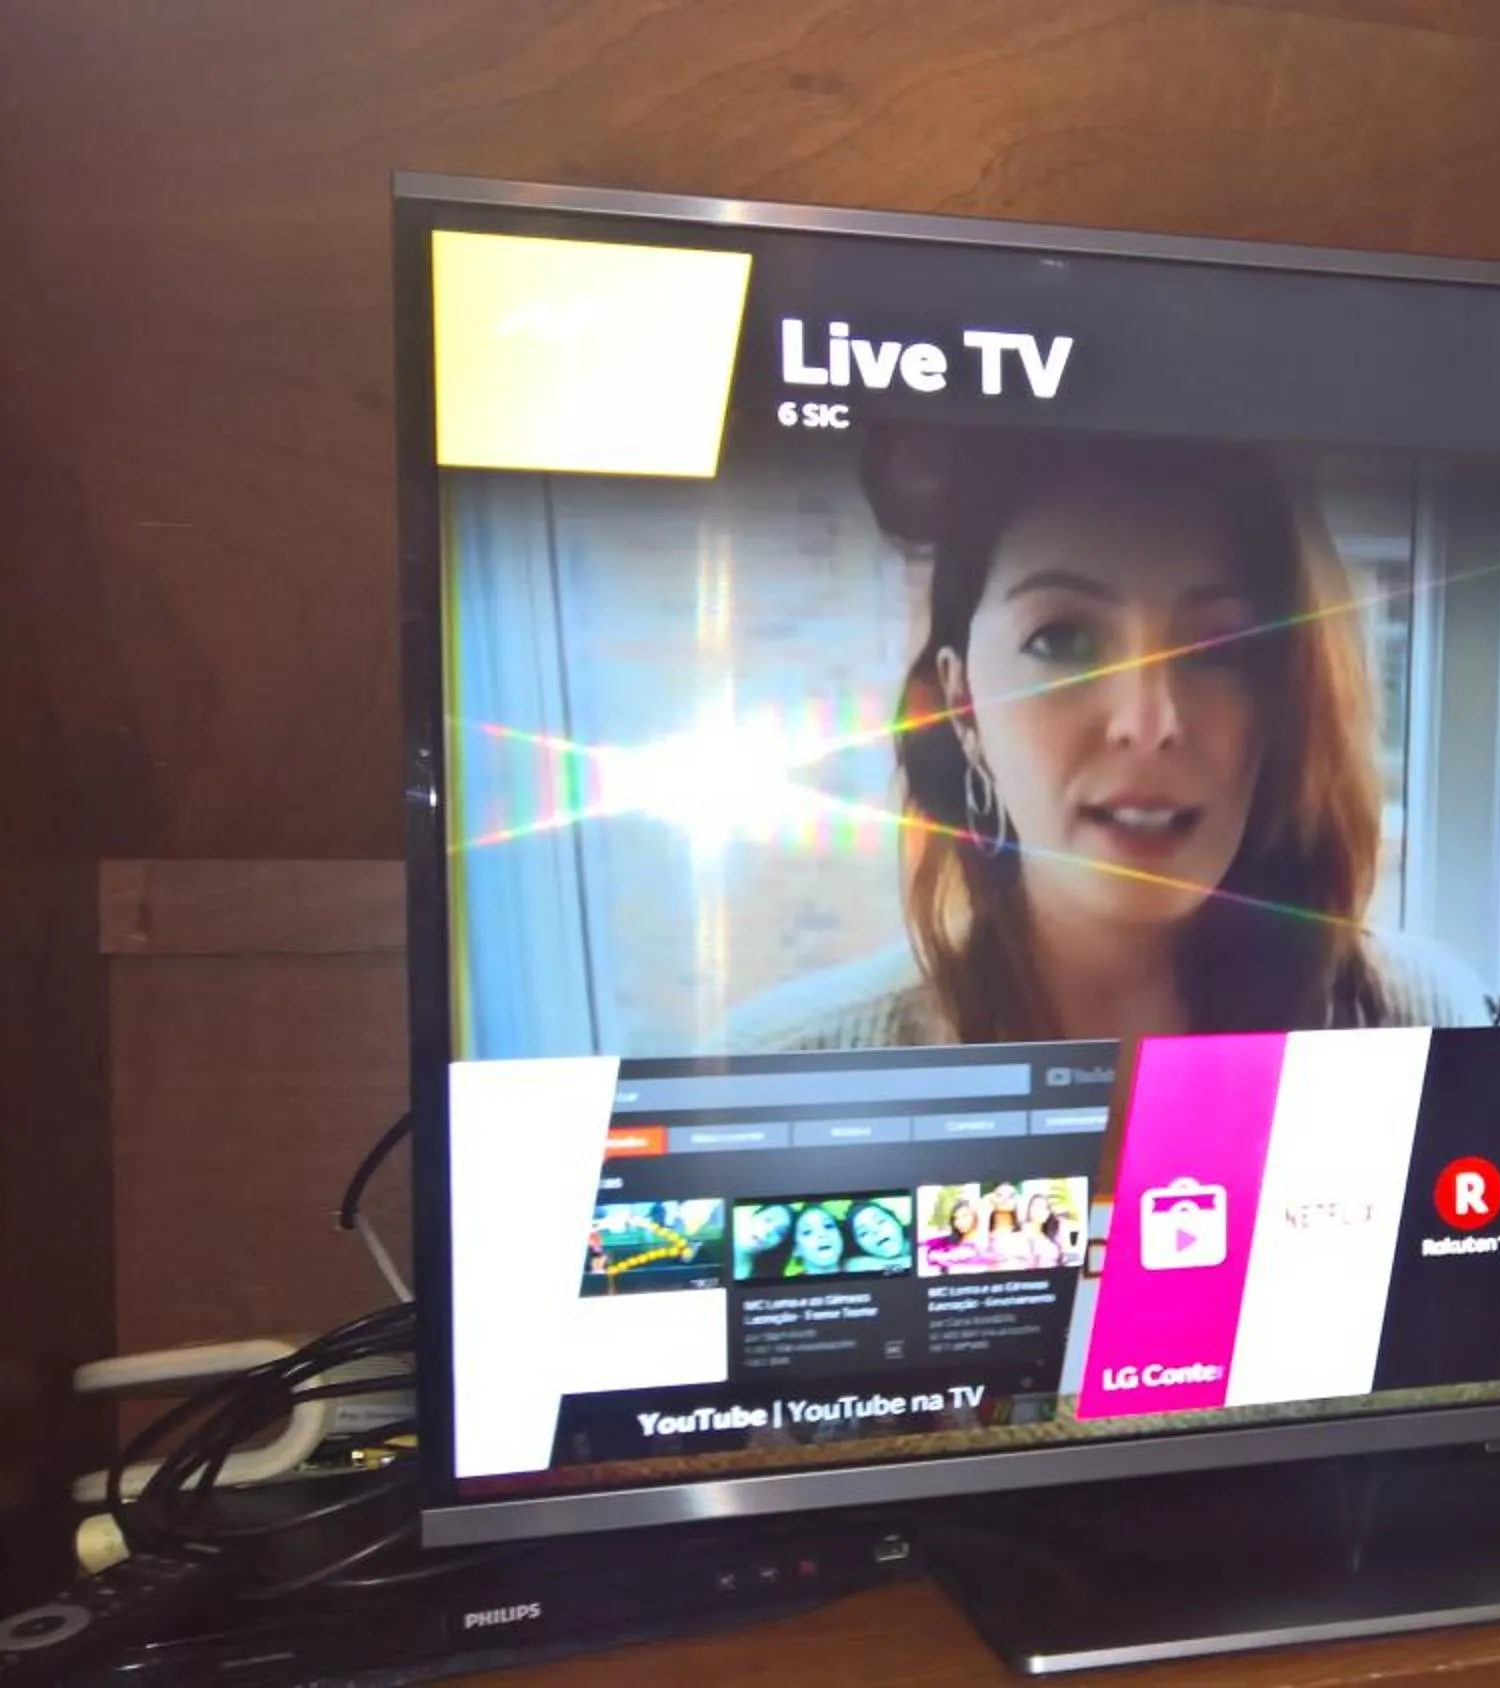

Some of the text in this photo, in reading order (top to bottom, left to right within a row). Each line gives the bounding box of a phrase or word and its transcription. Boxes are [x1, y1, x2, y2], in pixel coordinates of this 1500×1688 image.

[781, 318, 1074, 399] Live TV
[777, 400, 851, 429] 6 SIC
[1455, 1171, 1489, 1216] R
[1284, 1201, 1375, 1230] NETFLX
[1421, 1236, 1498, 1257] Rakuten
[1102, 1365, 1139, 1391] LG
[637, 1405, 768, 1436] YouTube
[788, 1394, 907, 1424] YouTube
[911, 1390, 945, 1412] na
[948, 1384, 985, 1409] TV
[463, 1601, 542, 1630] PHILIPS
